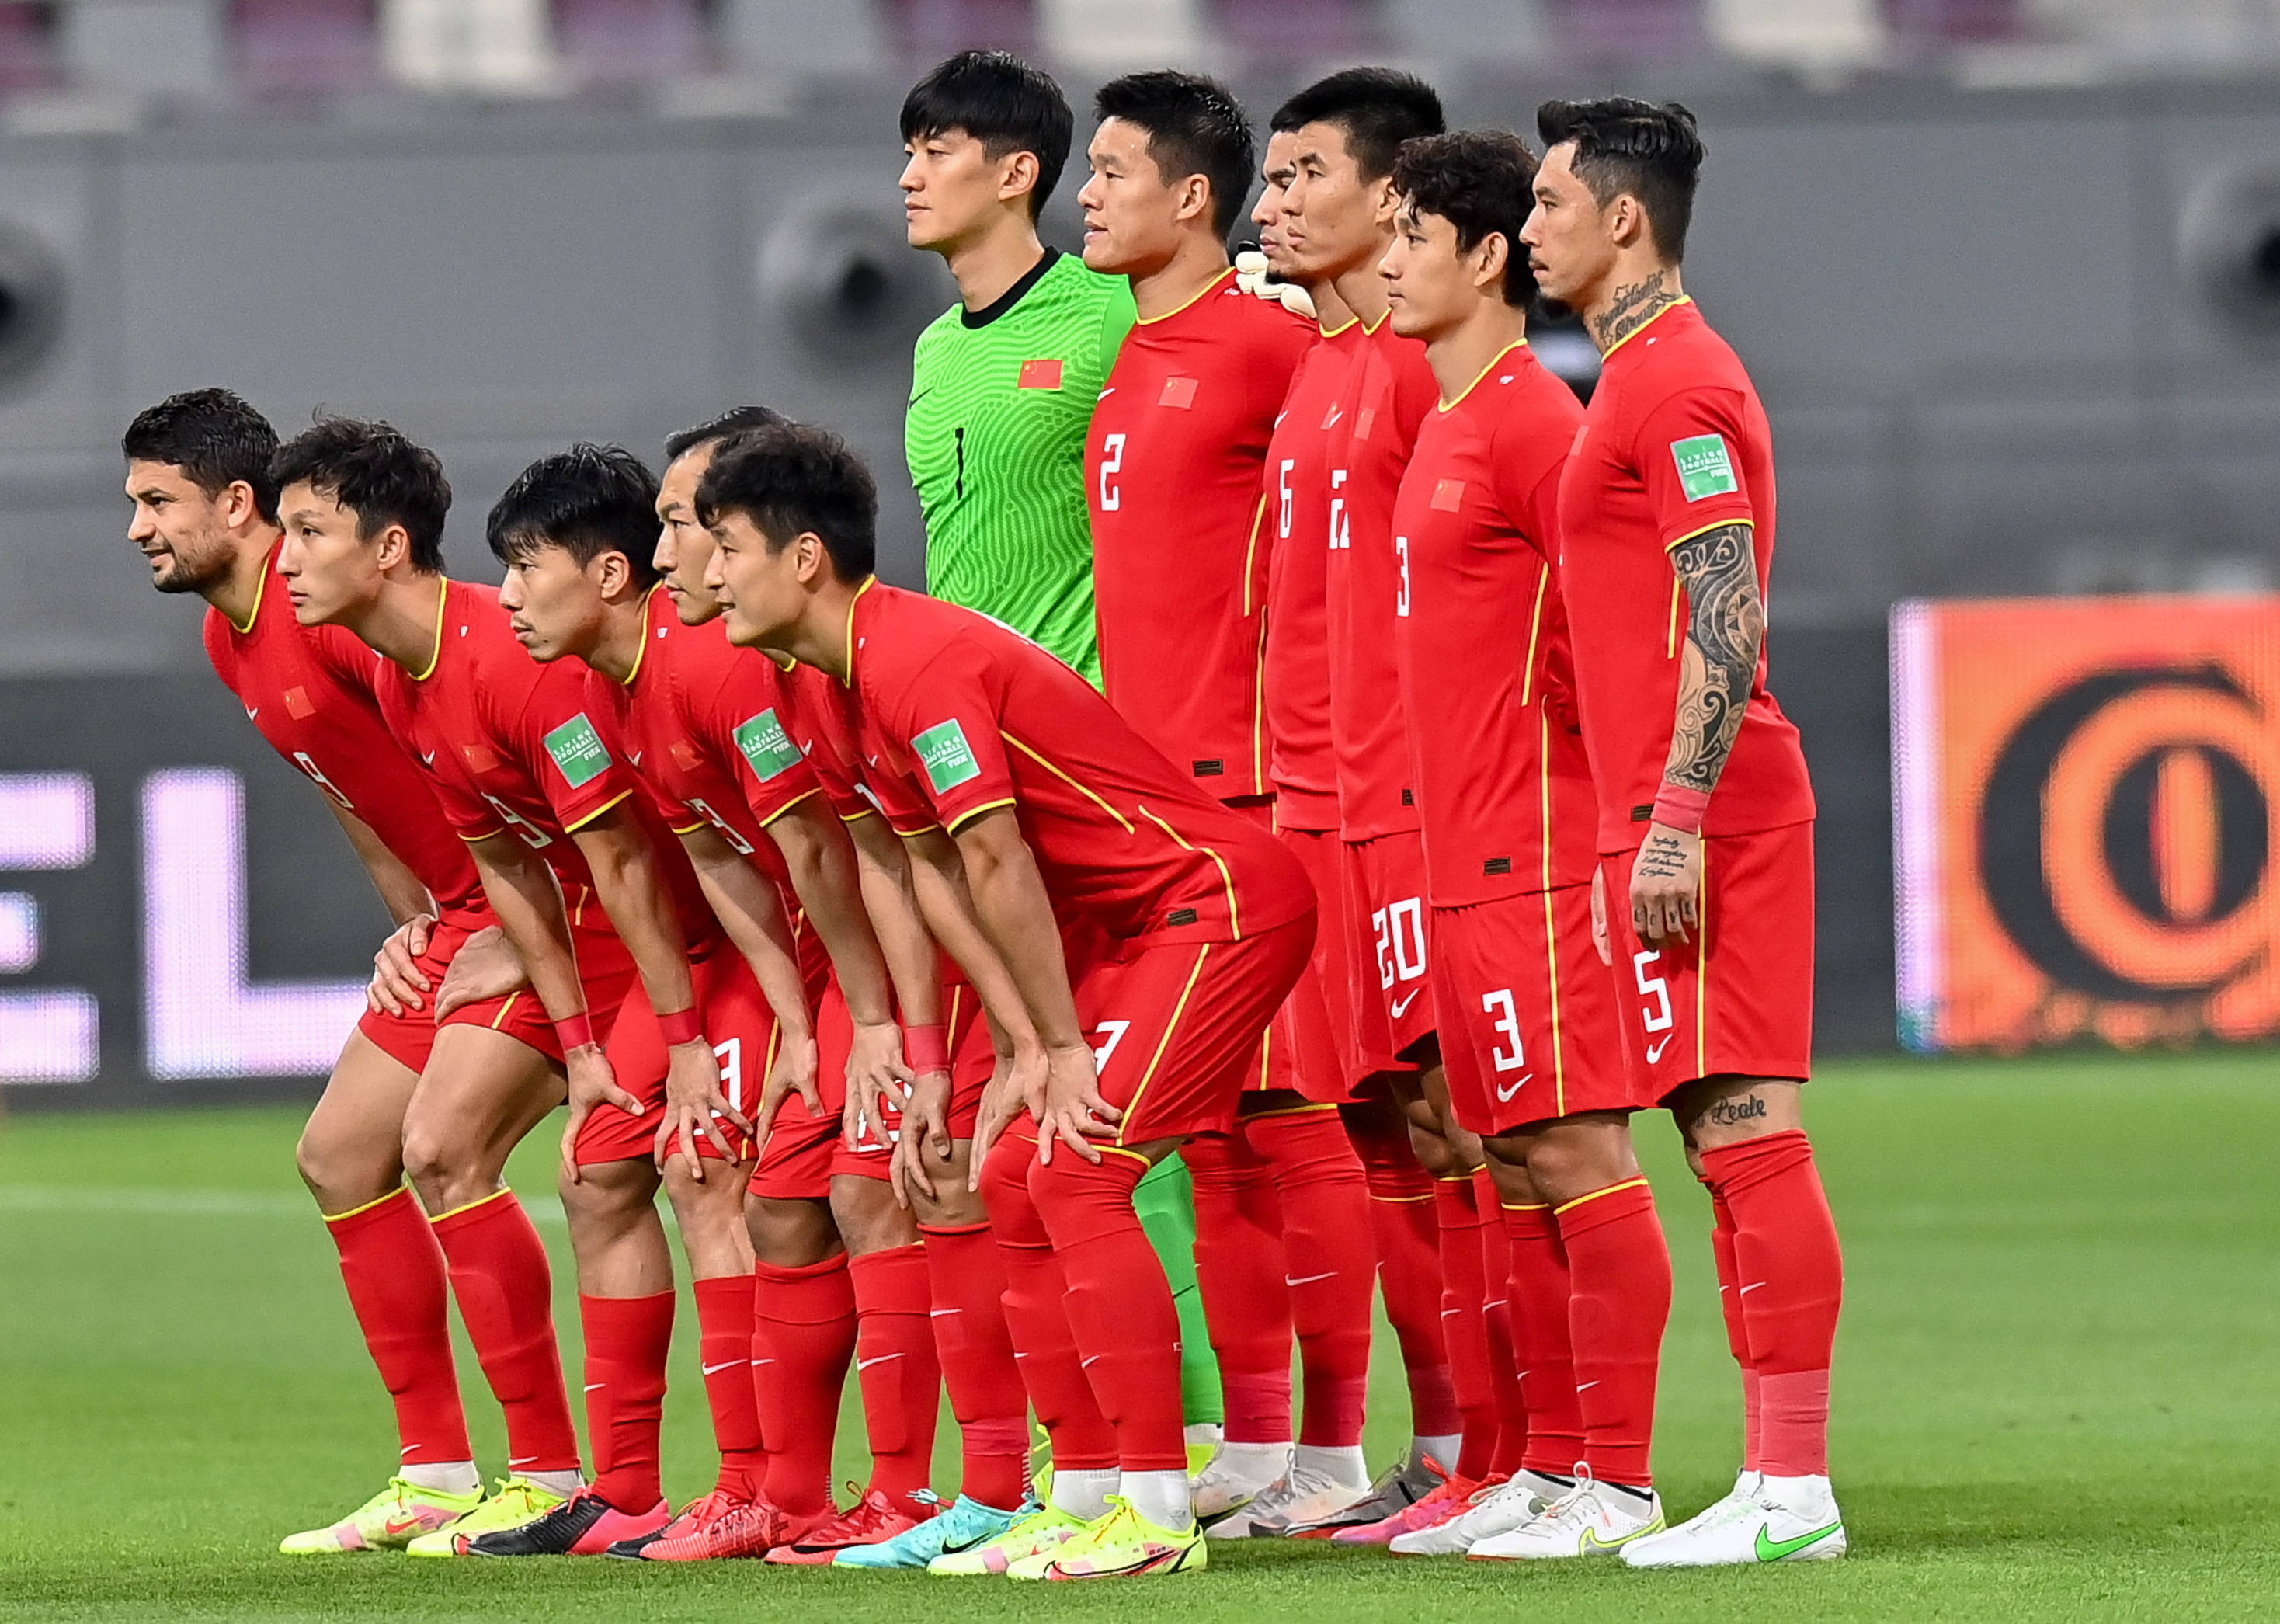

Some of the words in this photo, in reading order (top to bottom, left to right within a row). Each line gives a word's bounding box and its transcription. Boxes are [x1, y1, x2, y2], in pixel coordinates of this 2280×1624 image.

[954, 427, 964, 501] 1
[1100, 433, 1126, 512] 2
[1279, 459, 1295, 539] 6
[1396, 536, 1410, 617] 3
[554, 729, 590, 755] LIVING
[557, 735, 594, 761] FOOTBALL
[583, 746, 601, 761] FIFA
[773, 741, 791, 754] FIFA
[923, 736, 960, 759] LIVING
[926, 743, 964, 765] FOOTBALL
[947, 753, 968, 769] FIFA
[1372, 896, 1427, 990] 20
[1633, 949, 1674, 1033] 5
[1094, 1021, 1131, 1076] 7
[1482, 989, 1524, 1073] 3
